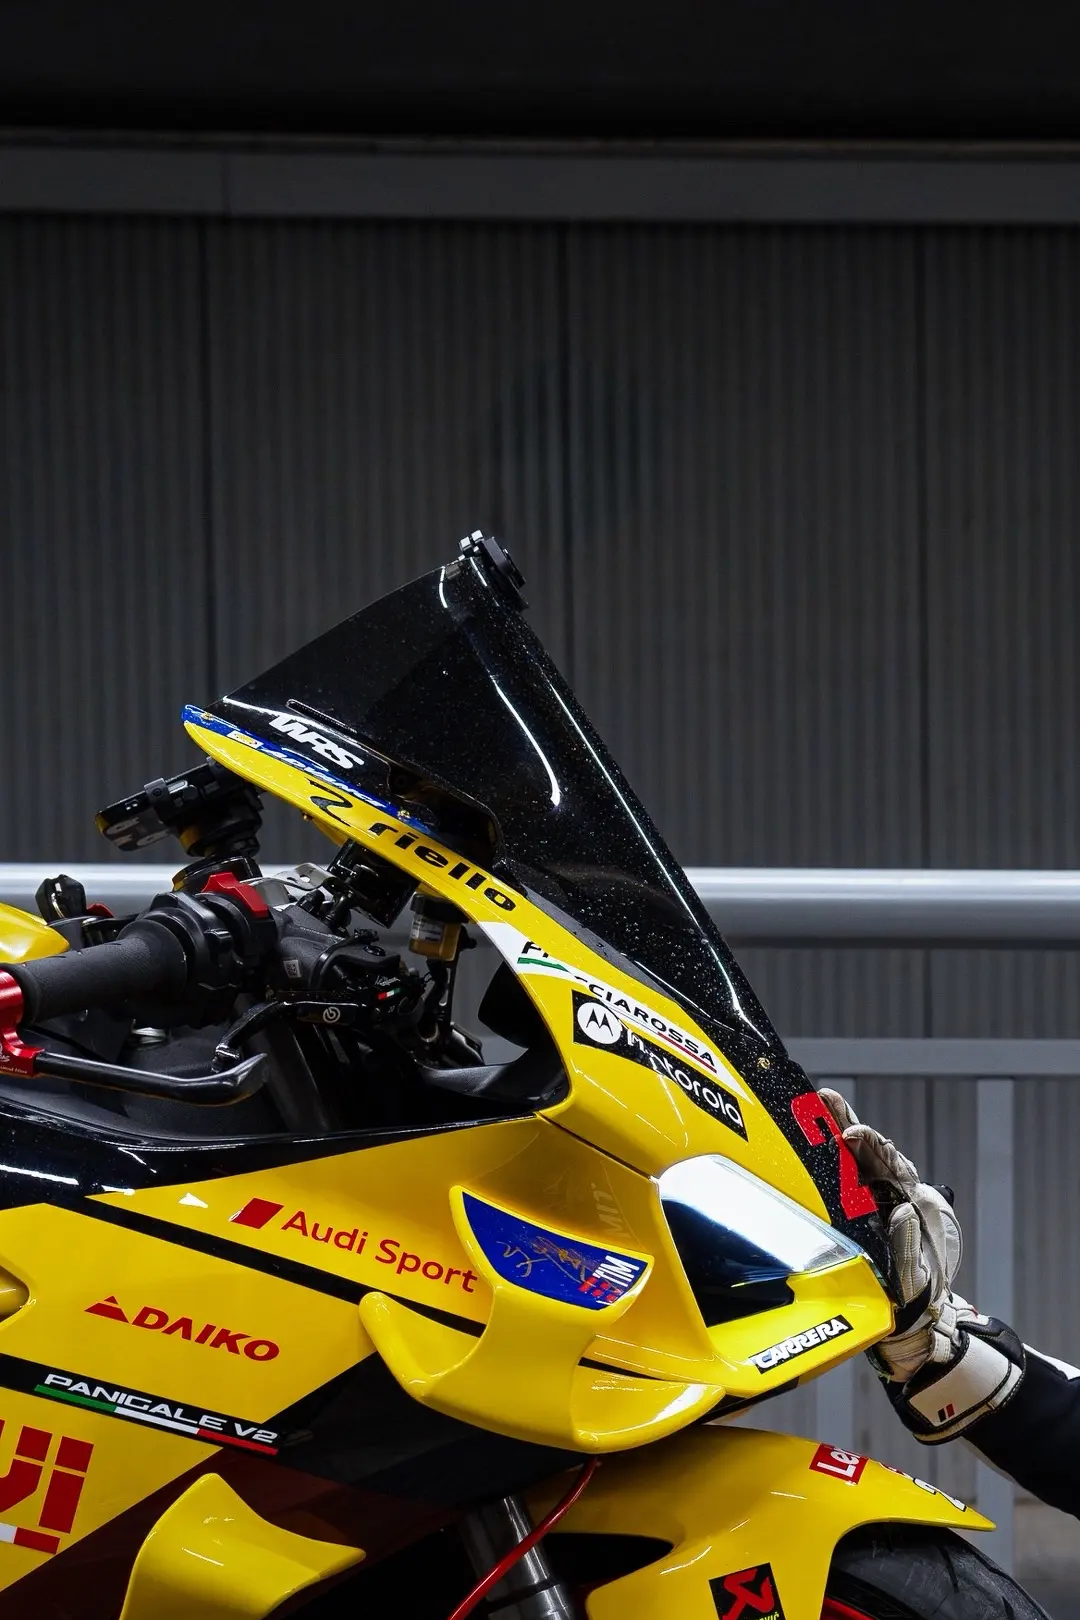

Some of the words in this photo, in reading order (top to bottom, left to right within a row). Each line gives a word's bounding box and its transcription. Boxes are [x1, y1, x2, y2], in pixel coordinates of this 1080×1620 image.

[268, 713, 366, 770] WRS
[368, 822, 517, 901] riello
[521, 941, 717, 1068] FCIAROSSA
[281, 1211, 368, 1256] Audi
[374, 1238, 480, 1293] Sport
[592, 1254, 640, 1288] TIM
[132, 1306, 281, 1363] DAIKO
[754, 1318, 849, 1370] CARRERA
[44, 1373, 228, 1431] PANIGALE
[234, 1422, 279, 1444] V2
